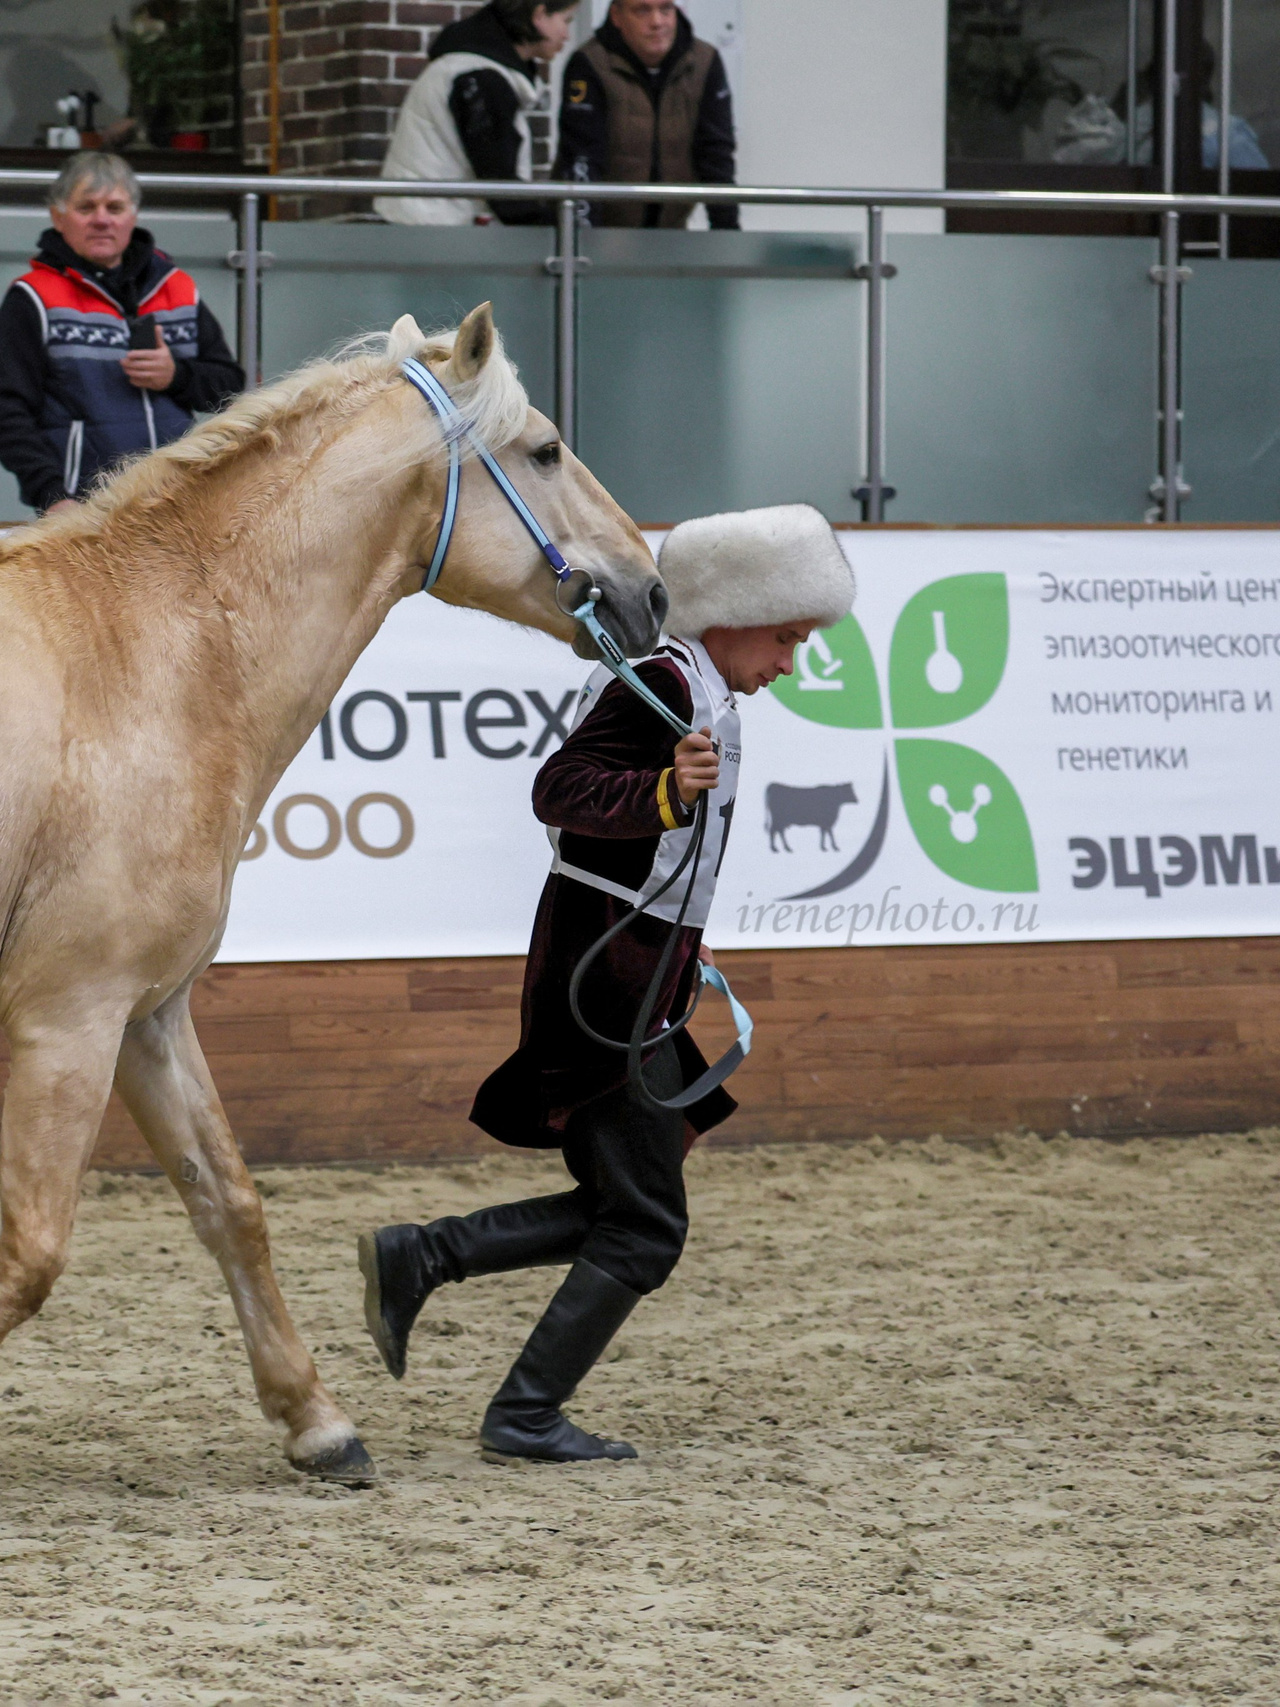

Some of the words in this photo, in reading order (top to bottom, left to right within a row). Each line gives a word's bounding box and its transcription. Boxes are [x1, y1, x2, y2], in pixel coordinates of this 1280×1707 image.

[1037, 571, 1218, 610] Экспертный
[1050, 690, 1246, 722] мониторинга
[1254, 690, 1273, 712] и
[1056, 746, 1189, 771] генетики
